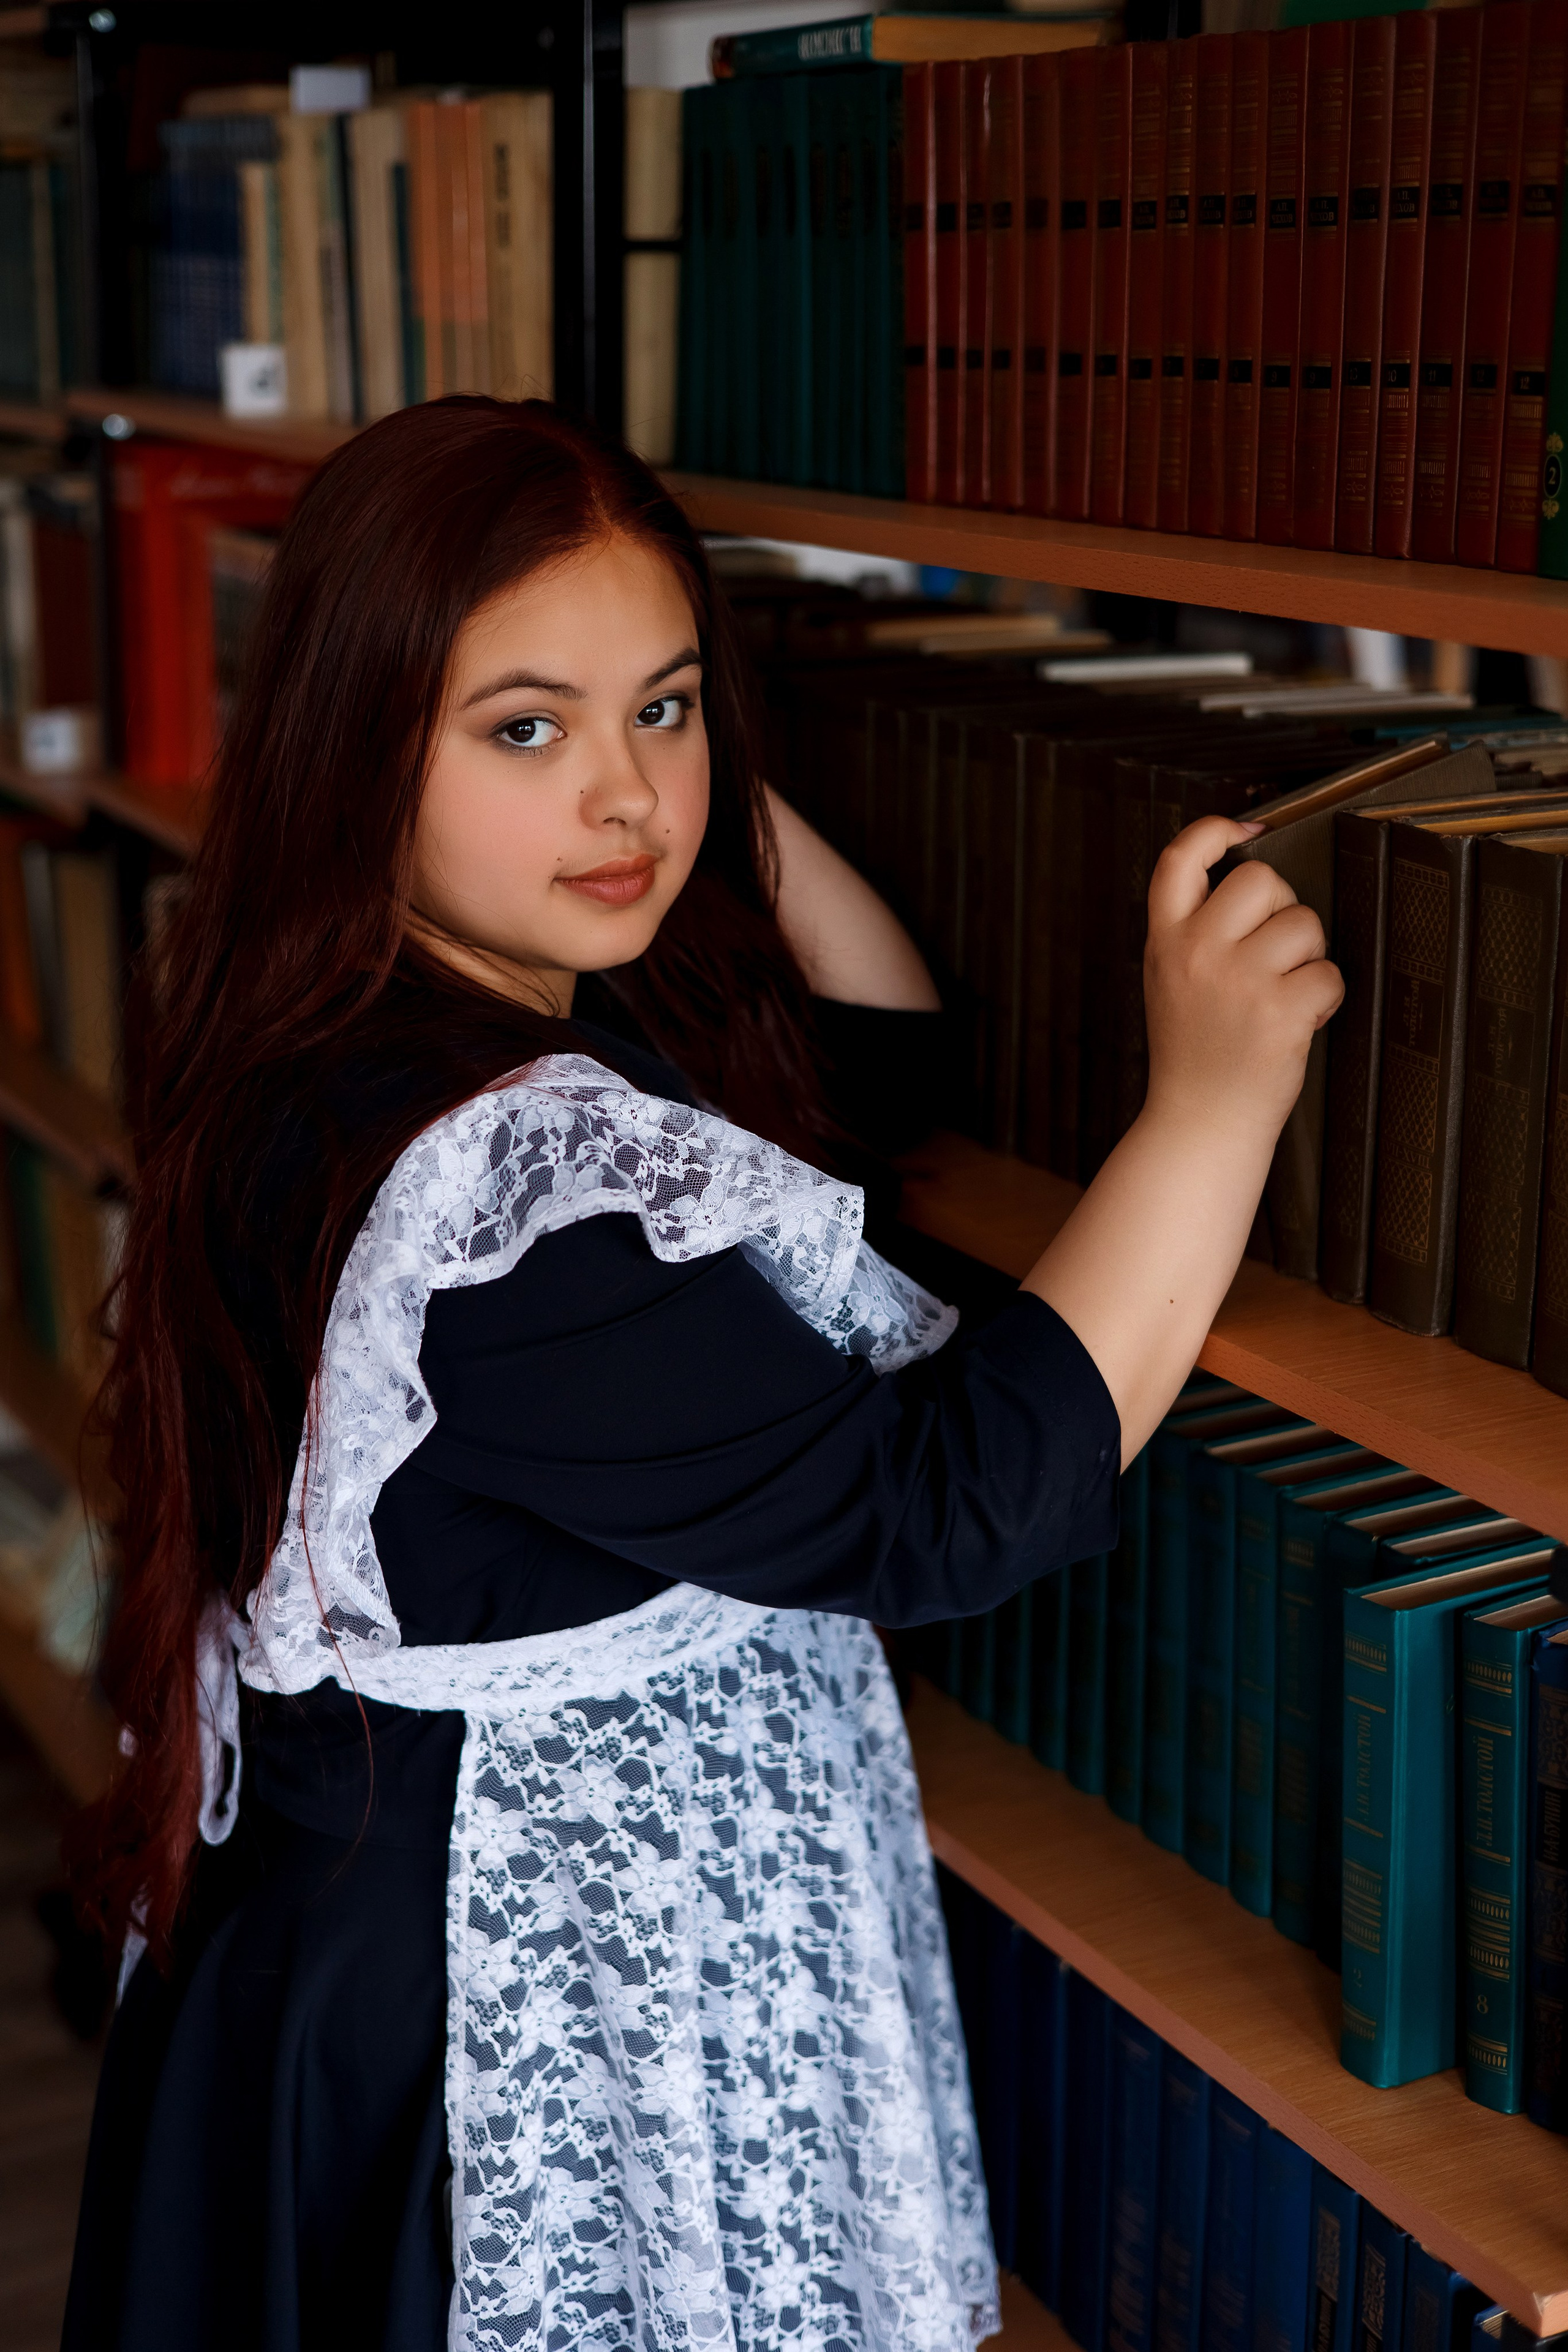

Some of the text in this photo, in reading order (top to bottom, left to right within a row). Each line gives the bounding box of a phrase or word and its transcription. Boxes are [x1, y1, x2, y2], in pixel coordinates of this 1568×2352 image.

[1547, 466, 1557, 485] 2
[1473, 1735, 1494, 1814] ТОЛСТОЙ
[1352, 1968, 1363, 1988] 2
[1476, 1994, 1489, 2015] 8
